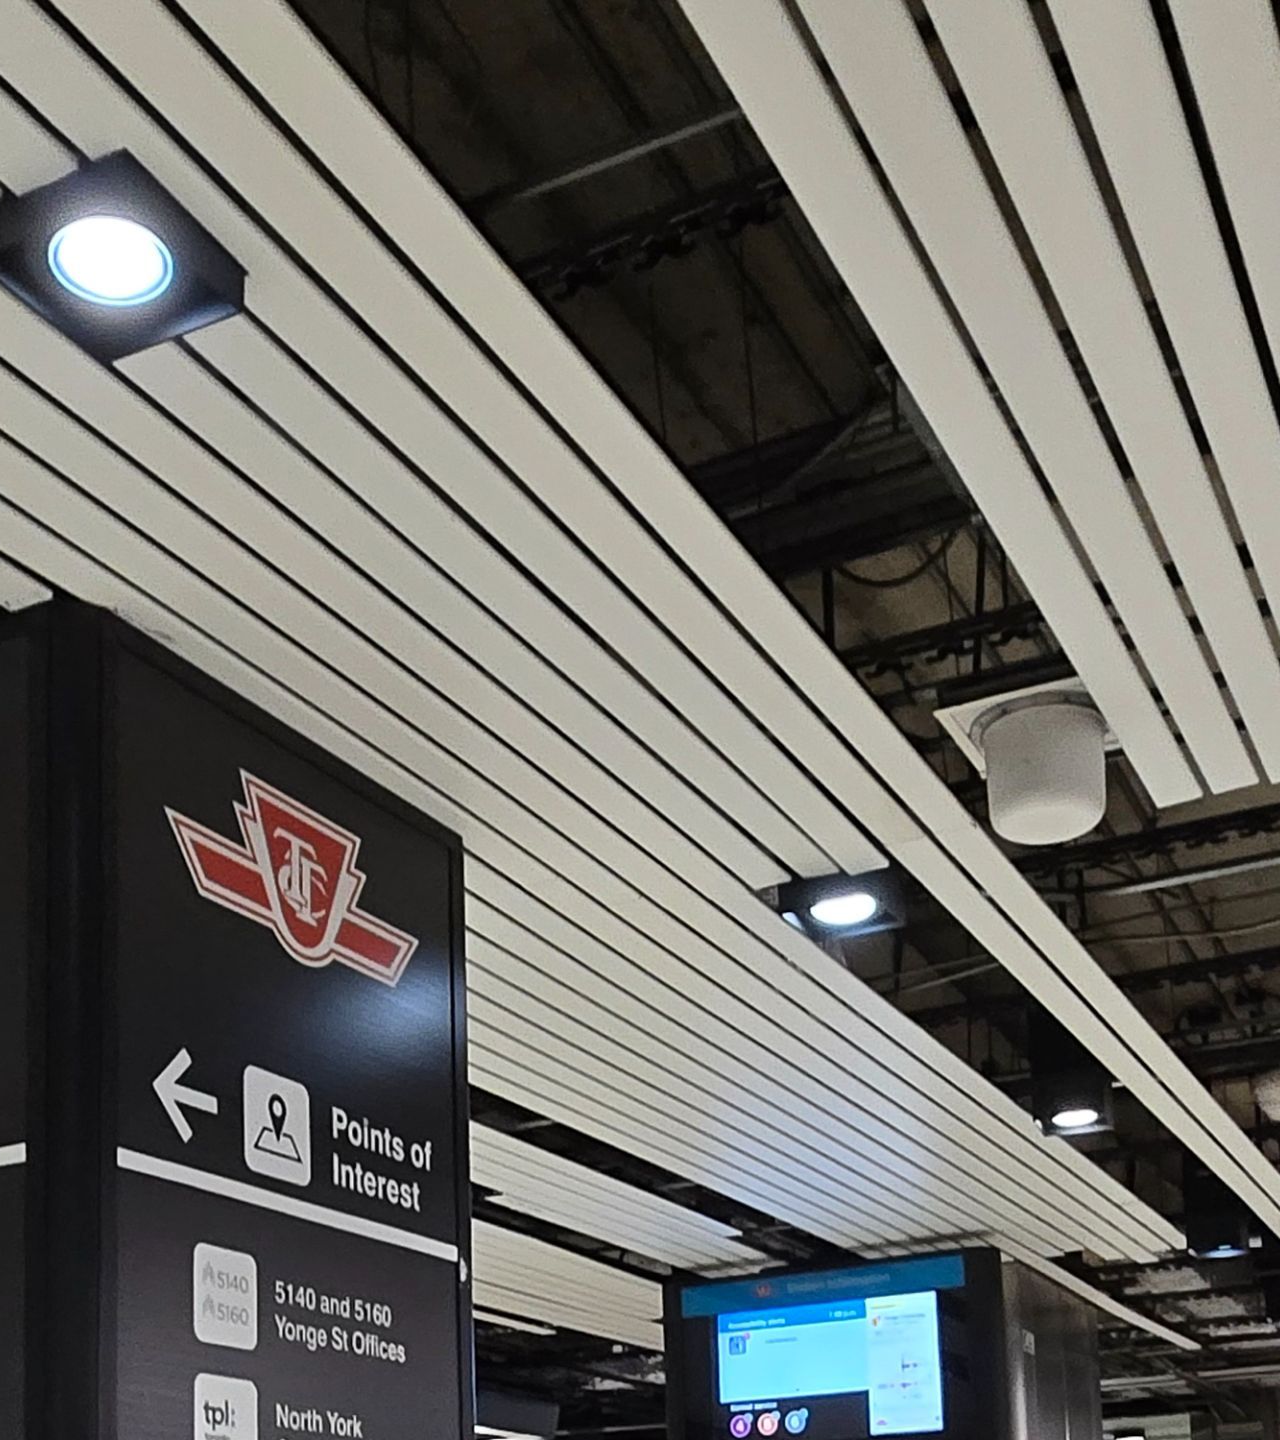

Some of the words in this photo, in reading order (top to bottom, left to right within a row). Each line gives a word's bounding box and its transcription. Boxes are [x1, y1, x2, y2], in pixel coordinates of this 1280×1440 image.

[332, 1106, 405, 1162] Points
[410, 1140, 432, 1171] of
[332, 1152, 421, 1212] Interest
[217, 1271, 250, 1294] 5140
[274, 1280, 317, 1311] 5140
[320, 1295, 351, 1319] and
[354, 1299, 393, 1329] 5160
[217, 1303, 250, 1327] 5160
[274, 1313, 328, 1352] Yonge
[331, 1326, 349, 1352] St
[352, 1331, 407, 1364] Offices
[275, 1402, 323, 1433] North
[326, 1410, 363, 1439] York
